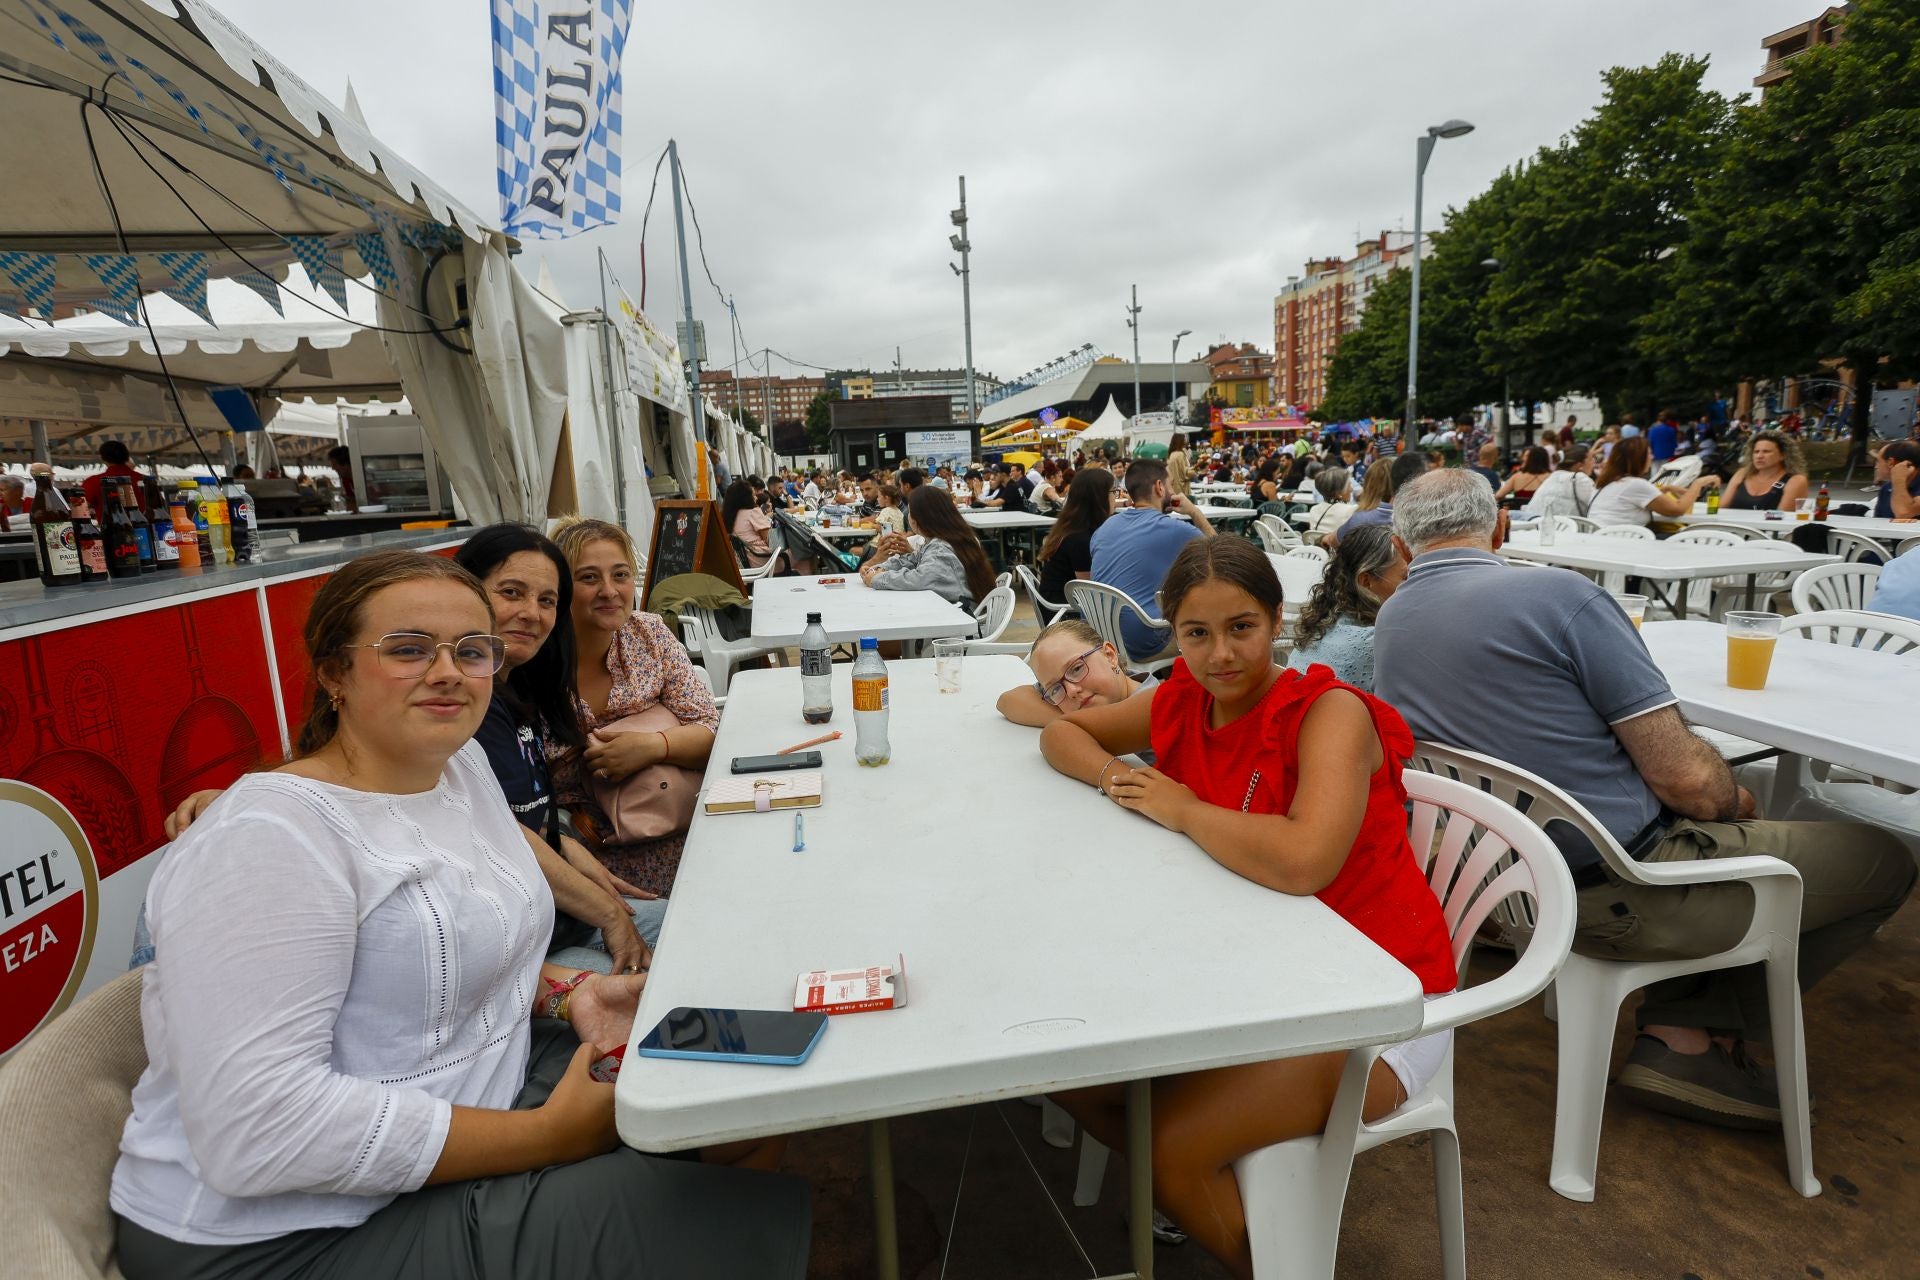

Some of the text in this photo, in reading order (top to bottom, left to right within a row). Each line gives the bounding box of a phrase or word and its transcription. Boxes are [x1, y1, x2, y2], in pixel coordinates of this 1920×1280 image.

[527, 0, 592, 219] PAULA
[920, 432, 931, 441] 30
[2, 924, 59, 974] EZA
